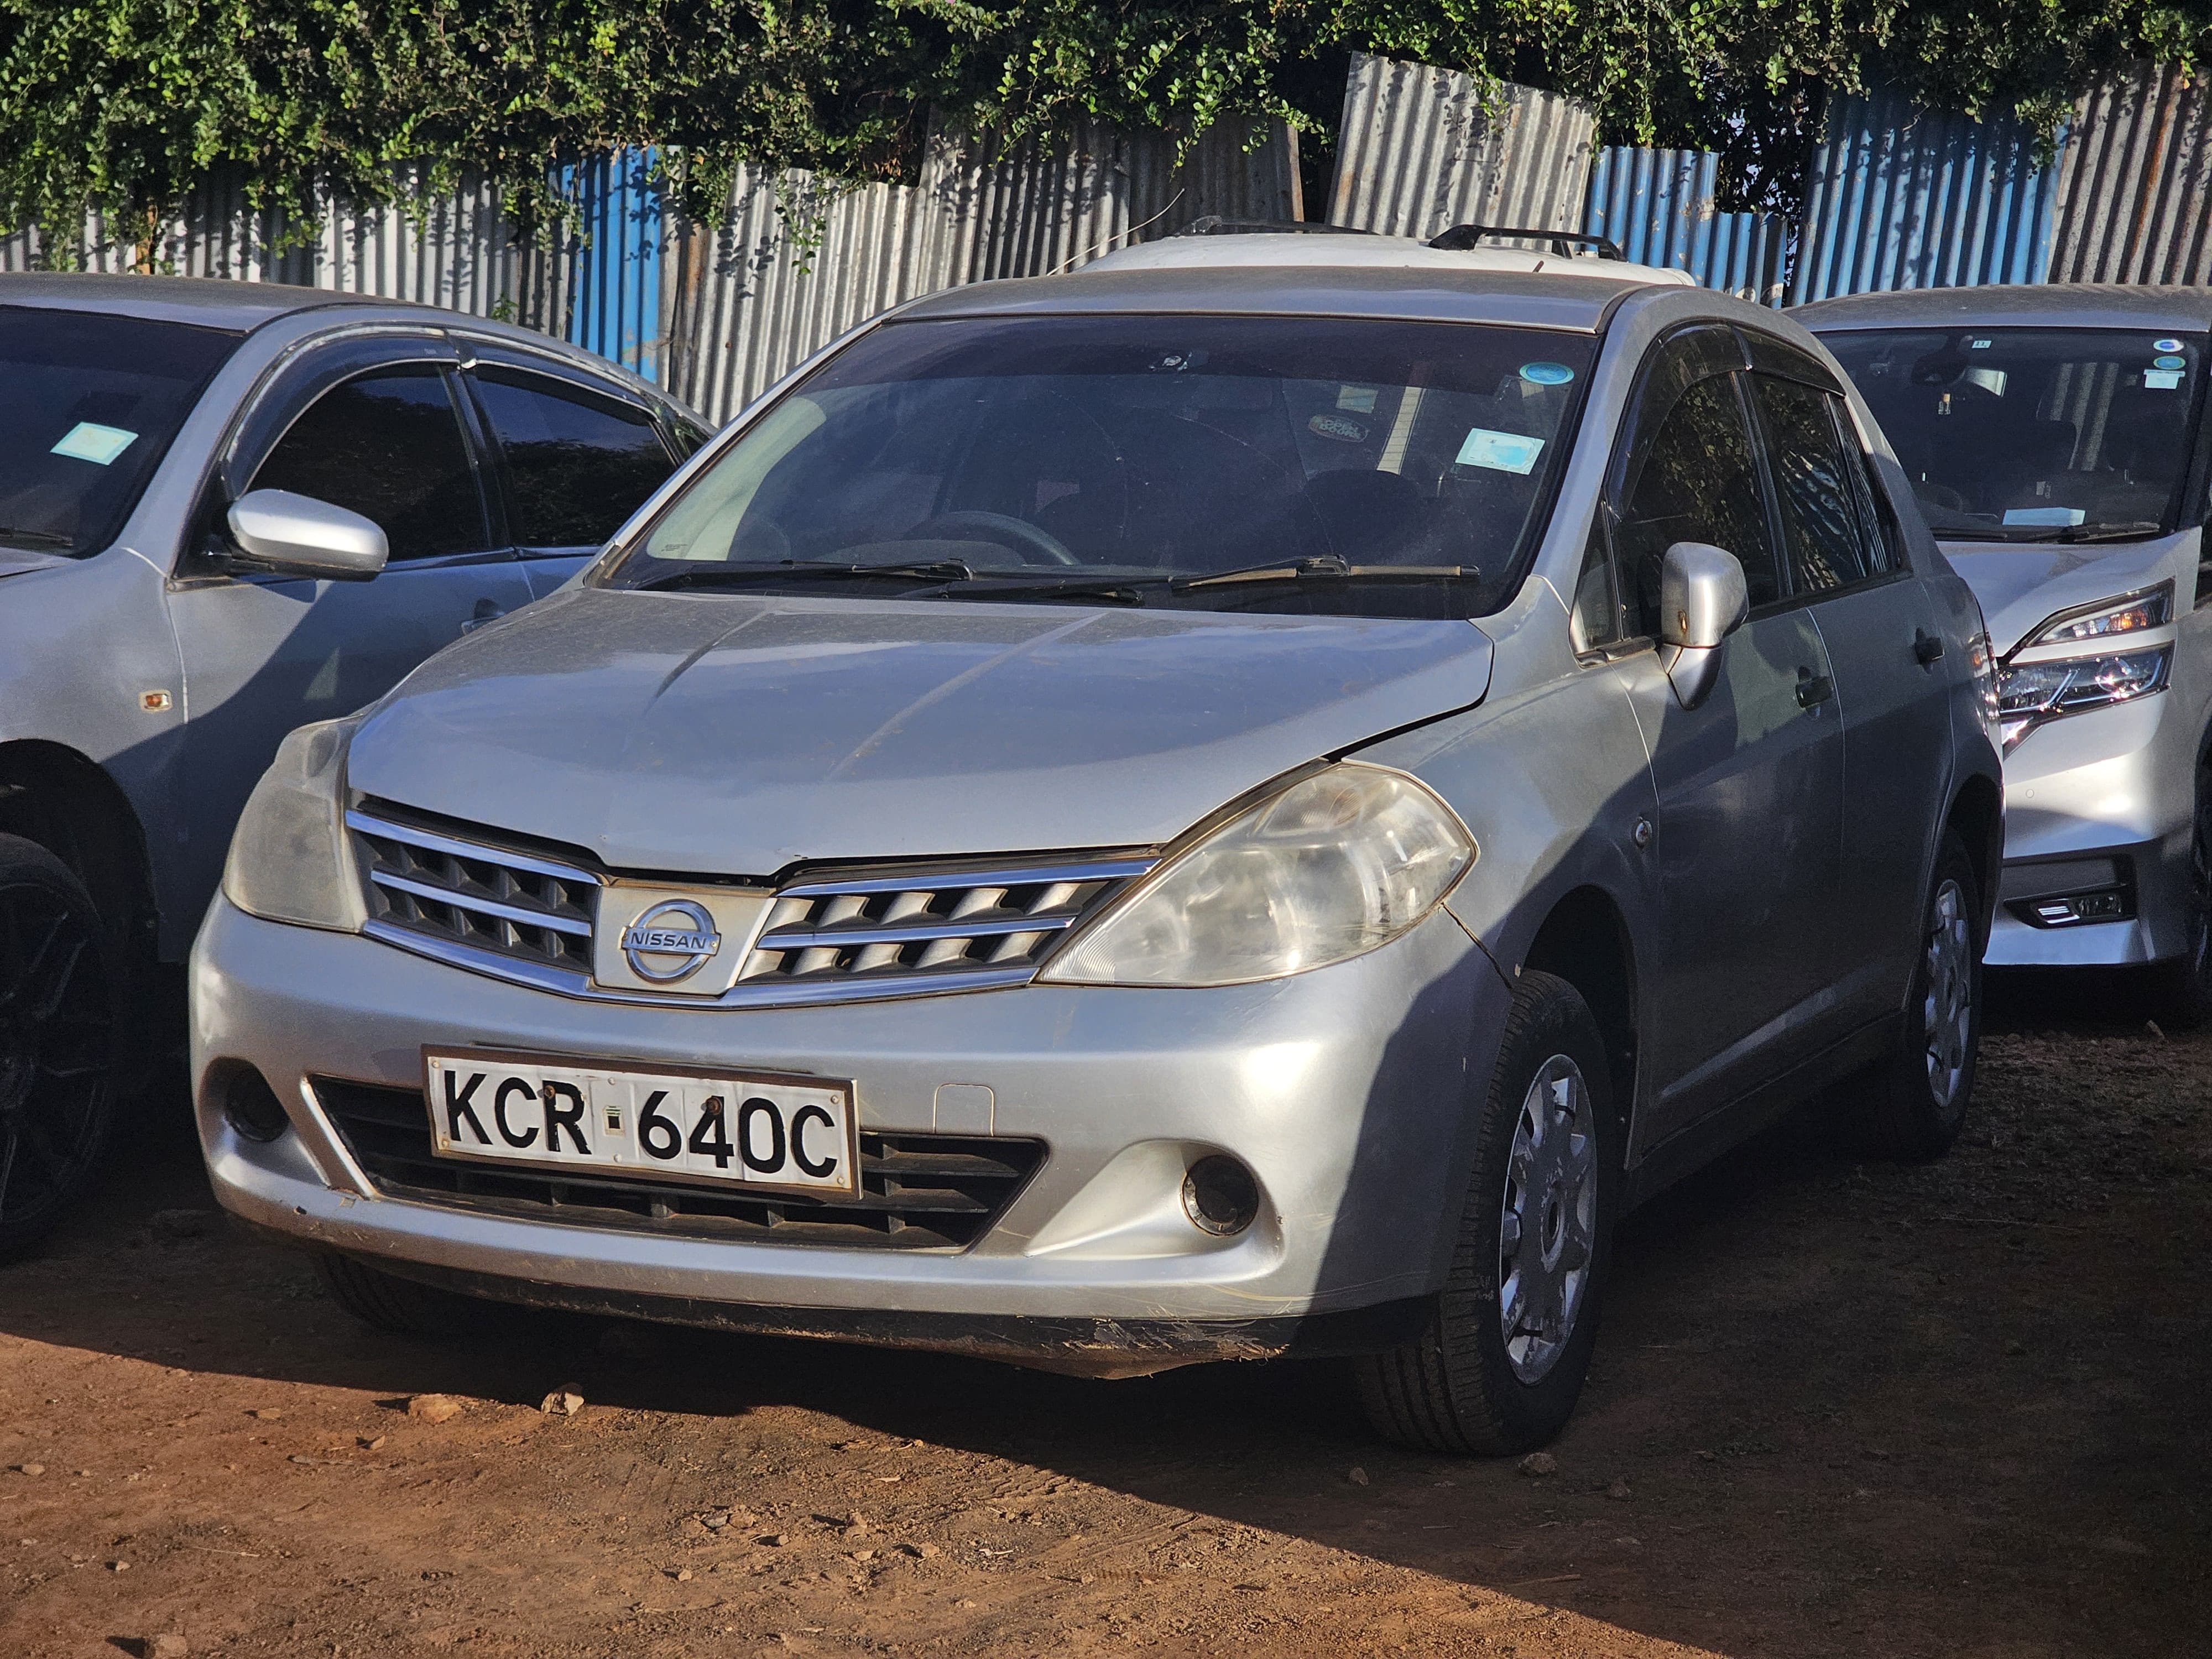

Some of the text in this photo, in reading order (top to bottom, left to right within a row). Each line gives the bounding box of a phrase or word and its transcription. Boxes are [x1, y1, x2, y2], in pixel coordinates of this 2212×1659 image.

[630, 932, 707, 949] NISSAN
[444, 1070, 838, 1178] KCR 640C
